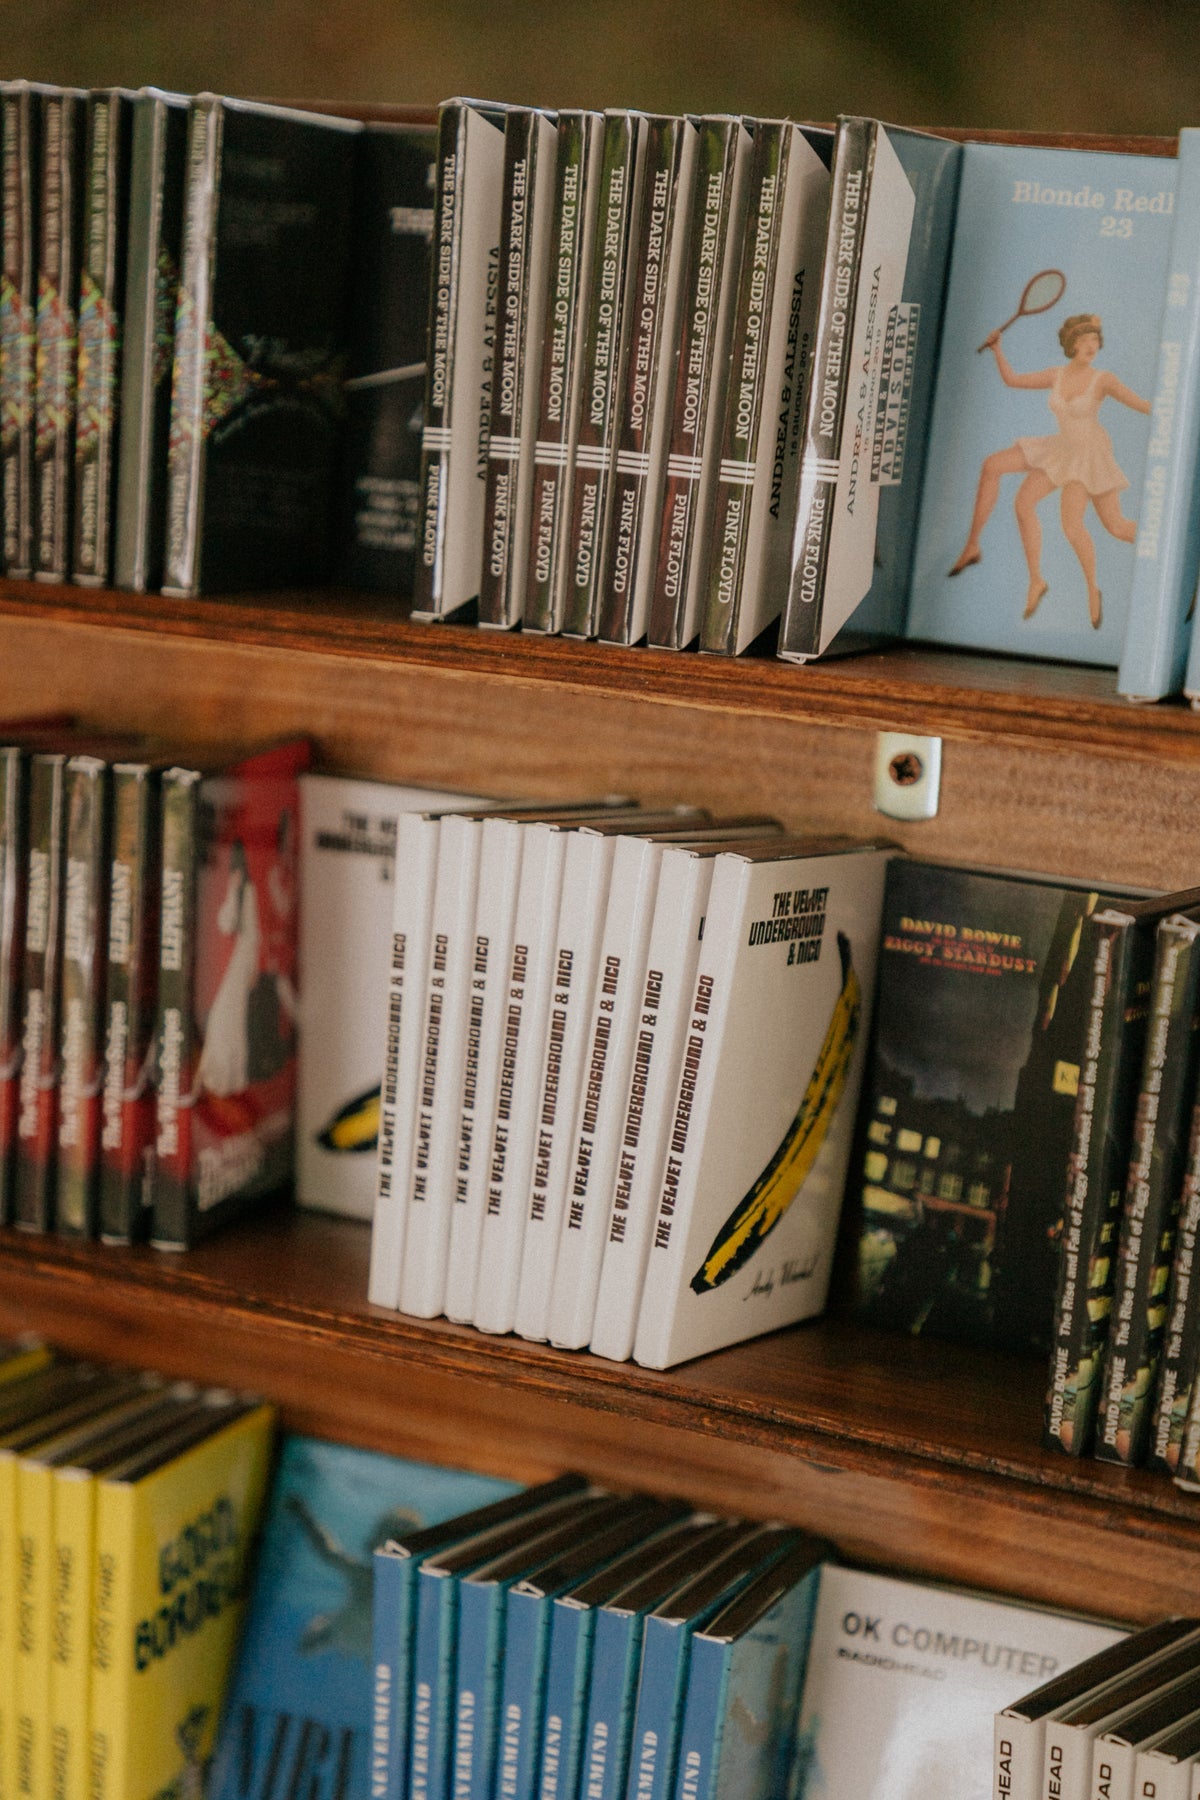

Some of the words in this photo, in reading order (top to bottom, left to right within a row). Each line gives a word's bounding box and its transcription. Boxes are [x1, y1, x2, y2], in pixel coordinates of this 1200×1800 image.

[443, 154, 456, 191] THE
[512, 159, 526, 196] THE
[563, 164, 577, 201] THE
[608, 166, 624, 203] THE
[652, 169, 669, 206] THE
[705, 172, 722, 209] THE
[842, 170, 862, 208] THE
[759, 175, 775, 213] THE
[1012, 180, 1104, 208] Blonde
[440, 194, 454, 243] DARK
[509, 199, 524, 249] DARK
[559, 204, 575, 254] DARK
[604, 207, 621, 257] DARK
[647, 210, 665, 261] DARK
[700, 213, 718, 263] DARK
[836, 212, 858, 264] DARK
[1100, 215, 1134, 238] 23
[753, 216, 771, 267] DARK
[438, 245, 452, 284] SIDE
[507, 251, 521, 291] SIDE
[556, 256, 572, 297] SIDE
[600, 259, 617, 300] SIDE
[642, 263, 660, 303] SIDE
[437, 288, 450, 312] OF
[695, 266, 713, 307] SIDE
[748, 270, 766, 312] SIDE
[831, 266, 852, 308] SIDE
[505, 295, 519, 319] OF
[554, 300, 569, 324] OF
[598, 303, 613, 328] OF
[640, 307, 654, 332] OF
[692, 310, 708, 336] OF
[746, 315, 762, 339] OF
[784, 268, 806, 379] ALESSIA
[828, 311, 847, 338] OF
[862, 264, 882, 374] ALESSIA
[435, 313, 449, 348] THE
[503, 320, 518, 357] THE
[551, 327, 567, 362] THE
[594, 329, 611, 366] THE
[635, 333, 653, 371] THE
[688, 337, 705, 374] THE
[741, 341, 759, 379] THE
[824, 339, 844, 376] THE
[433, 352, 448, 407] MOON
[500, 360, 516, 415] MOON
[548, 366, 565, 421] MOON
[590, 369, 608, 424] MOON
[782, 390, 791, 402] &
[860, 384, 867, 400] &
[872, 411, 886, 477] ANDREA
[881, 306, 898, 380] ALESSIA
[881, 314, 908, 474] ADVISORY
[630, 374, 649, 430] MOON
[682, 377, 701, 433] MOON
[735, 382, 755, 439] MOON
[818, 379, 839, 436] MOON
[769, 404, 790, 520] ANDREA
[847, 405, 866, 516] ANDREA
[427, 465, 440, 507] PINK
[494, 474, 508, 517] PINK
[539, 480, 555, 523] PINK
[580, 484, 596, 527] PINK
[619, 489, 635, 532] PINK
[670, 493, 687, 537] PINK
[723, 499, 740, 544] PINK
[806, 497, 825, 542] PINK
[423, 509, 438, 566] FLOYD
[490, 519, 506, 576] FLOYD
[535, 525, 552, 582] FLOYD
[575, 529, 593, 586] FLOYD
[613, 535, 631, 592] FLOYD
[664, 540, 682, 596] FLOYD
[717, 545, 736, 603] FLOYD
[800, 545, 820, 602] FLOYD
[772, 891, 792, 918] THE
[793, 887, 829, 914] VELVET
[748, 913, 826, 946] UNDERGROUND
[900, 917, 956, 938] DAVID
[962, 927, 1022, 949] BOWIE
[433, 934, 447, 971] NICO
[474, 936, 489, 973] NICO
[511, 944, 528, 982] NICO
[556, 949, 574, 987] NICO
[787, 942, 796, 966] &
[796, 938, 821, 964] NICO
[884, 936, 934, 956] ZIGGY
[943, 947, 1036, 973] STARDUST
[432, 978, 444, 987] &
[473, 980, 485, 989] &
[510, 988, 524, 999] &
[601, 956, 621, 994] NICO
[644, 970, 663, 1009] NICO
[694, 974, 714, 1014] NICO
[554, 993, 569, 1004] &
[599, 1000, 614, 1012] &
[641, 1014, 657, 1026] &
[691, 1019, 707, 1031] &
[421, 994, 442, 1106] UNDERGROUND
[463, 996, 484, 1109] UNDERGROUND
[497, 1004, 522, 1119] UNDERGROUND
[541, 1009, 567, 1125] UNDERGROUND
[581, 1016, 612, 1133] UNDERGROUND
[623, 1030, 655, 1147] UNDERGROUND
[670, 1035, 704, 1153] UNDERGROUND
[416, 1113, 432, 1168] VELVET
[458, 1115, 474, 1170] VELVET
[490, 1124, 509, 1182] VELVET
[534, 1129, 553, 1188] VELVET
[572, 1137, 594, 1196] VELVET
[614, 1150, 636, 1209] VELVET
[660, 1156, 683, 1215] VELVET
[413, 1175, 427, 1200] THE
[455, 1178, 468, 1203] THE
[487, 1188, 502, 1215] THE
[530, 1193, 546, 1220] THE
[1071, 1172, 1089, 1209] Ziggy
[568, 1201, 584, 1230] THE
[609, 1214, 627, 1243] THE
[654, 1220, 672, 1249] THE
[1070, 1210, 1082, 1226] of
[1066, 1228, 1080, 1252] Fall
[1065, 1255, 1078, 1279] and
[1062, 1281, 1075, 1309] Rise
[1059, 1312, 1072, 1336] The
[1053, 1346, 1069, 1392] BOWIE
[1049, 1395, 1064, 1435] DAVID
[842, 1612, 881, 1642] OK
[893, 1624, 1058, 1678] COMPUTER
[371, 1664, 391, 1796] NEVERMIND
